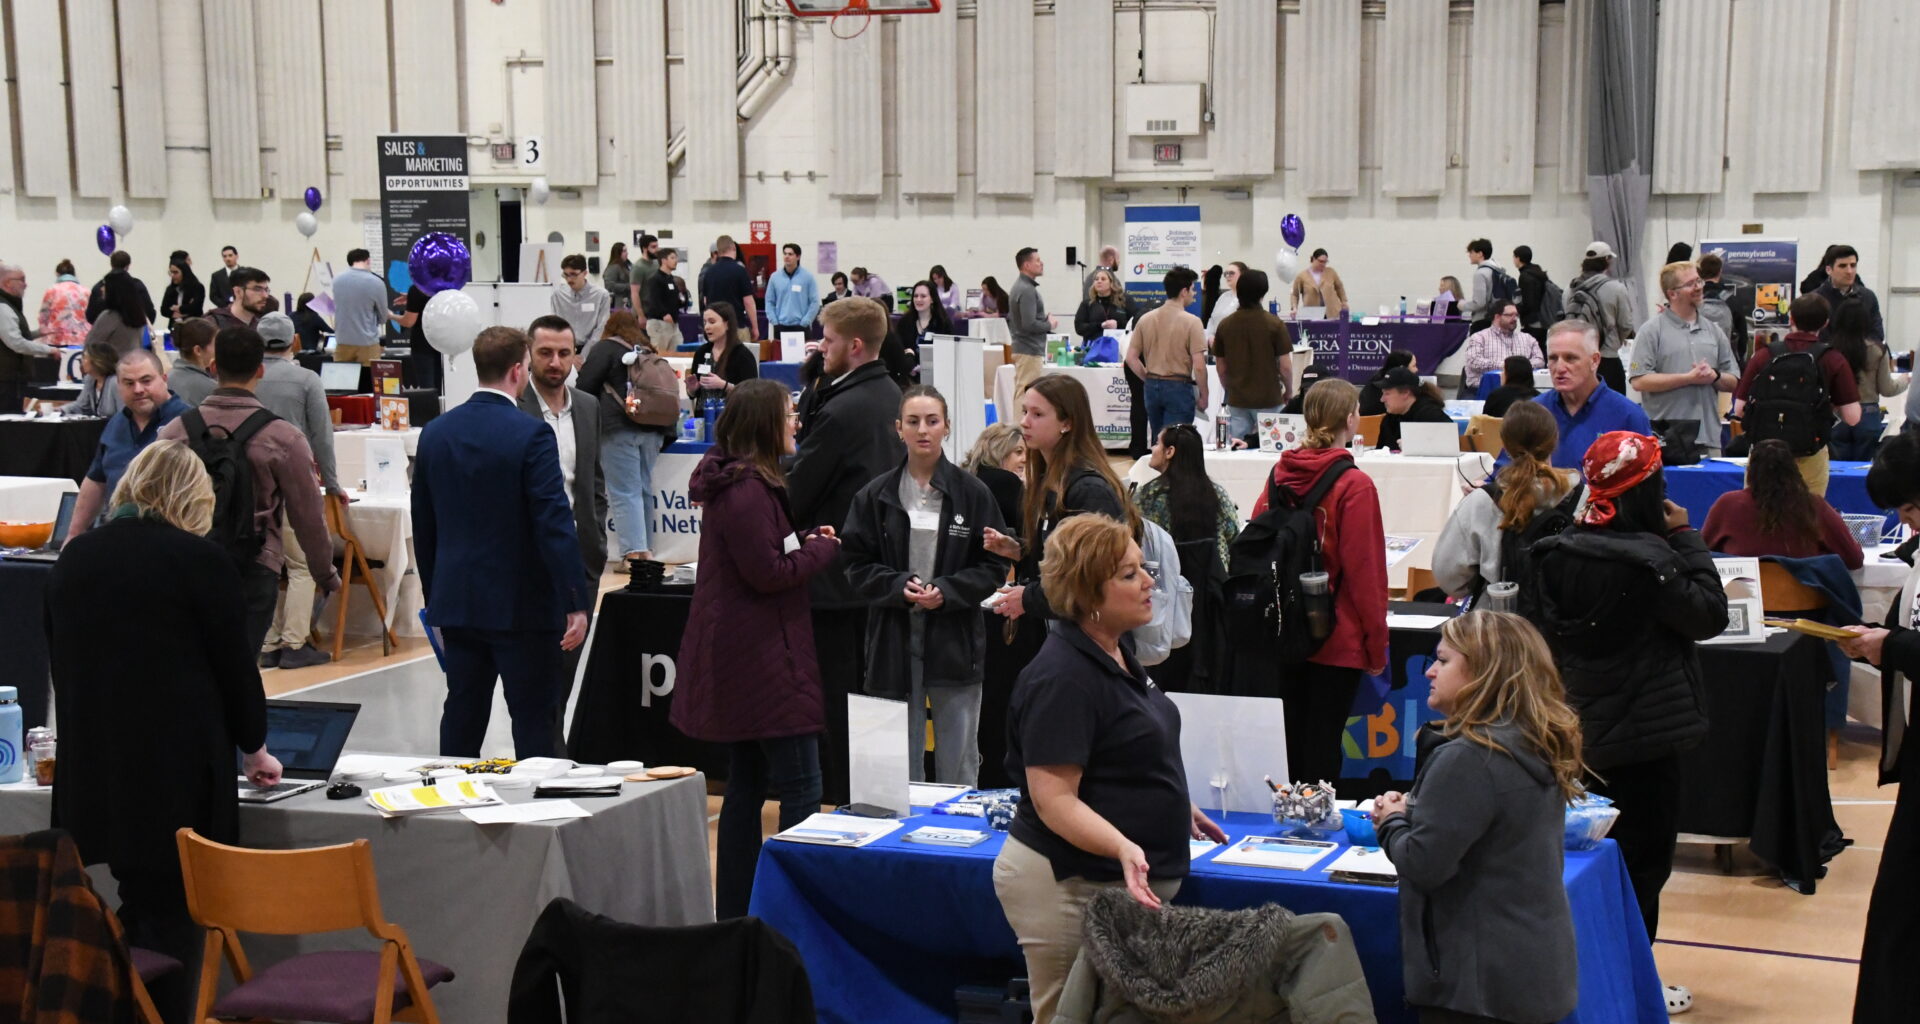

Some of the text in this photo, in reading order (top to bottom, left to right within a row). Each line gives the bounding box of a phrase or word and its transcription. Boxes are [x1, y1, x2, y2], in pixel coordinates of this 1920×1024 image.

[384, 141, 426, 156] SALES &
[525, 139, 539, 164] 3
[1158, 145, 1178, 160] EXIT
[405, 157, 463, 172] MARKETING
[388, 178, 464, 189] OPPORTUNITIES
[1727, 249, 1776, 259] pennsylvania
[1298, 339, 1393, 354] CRATON
[1118, 395, 1132, 403] Ce
